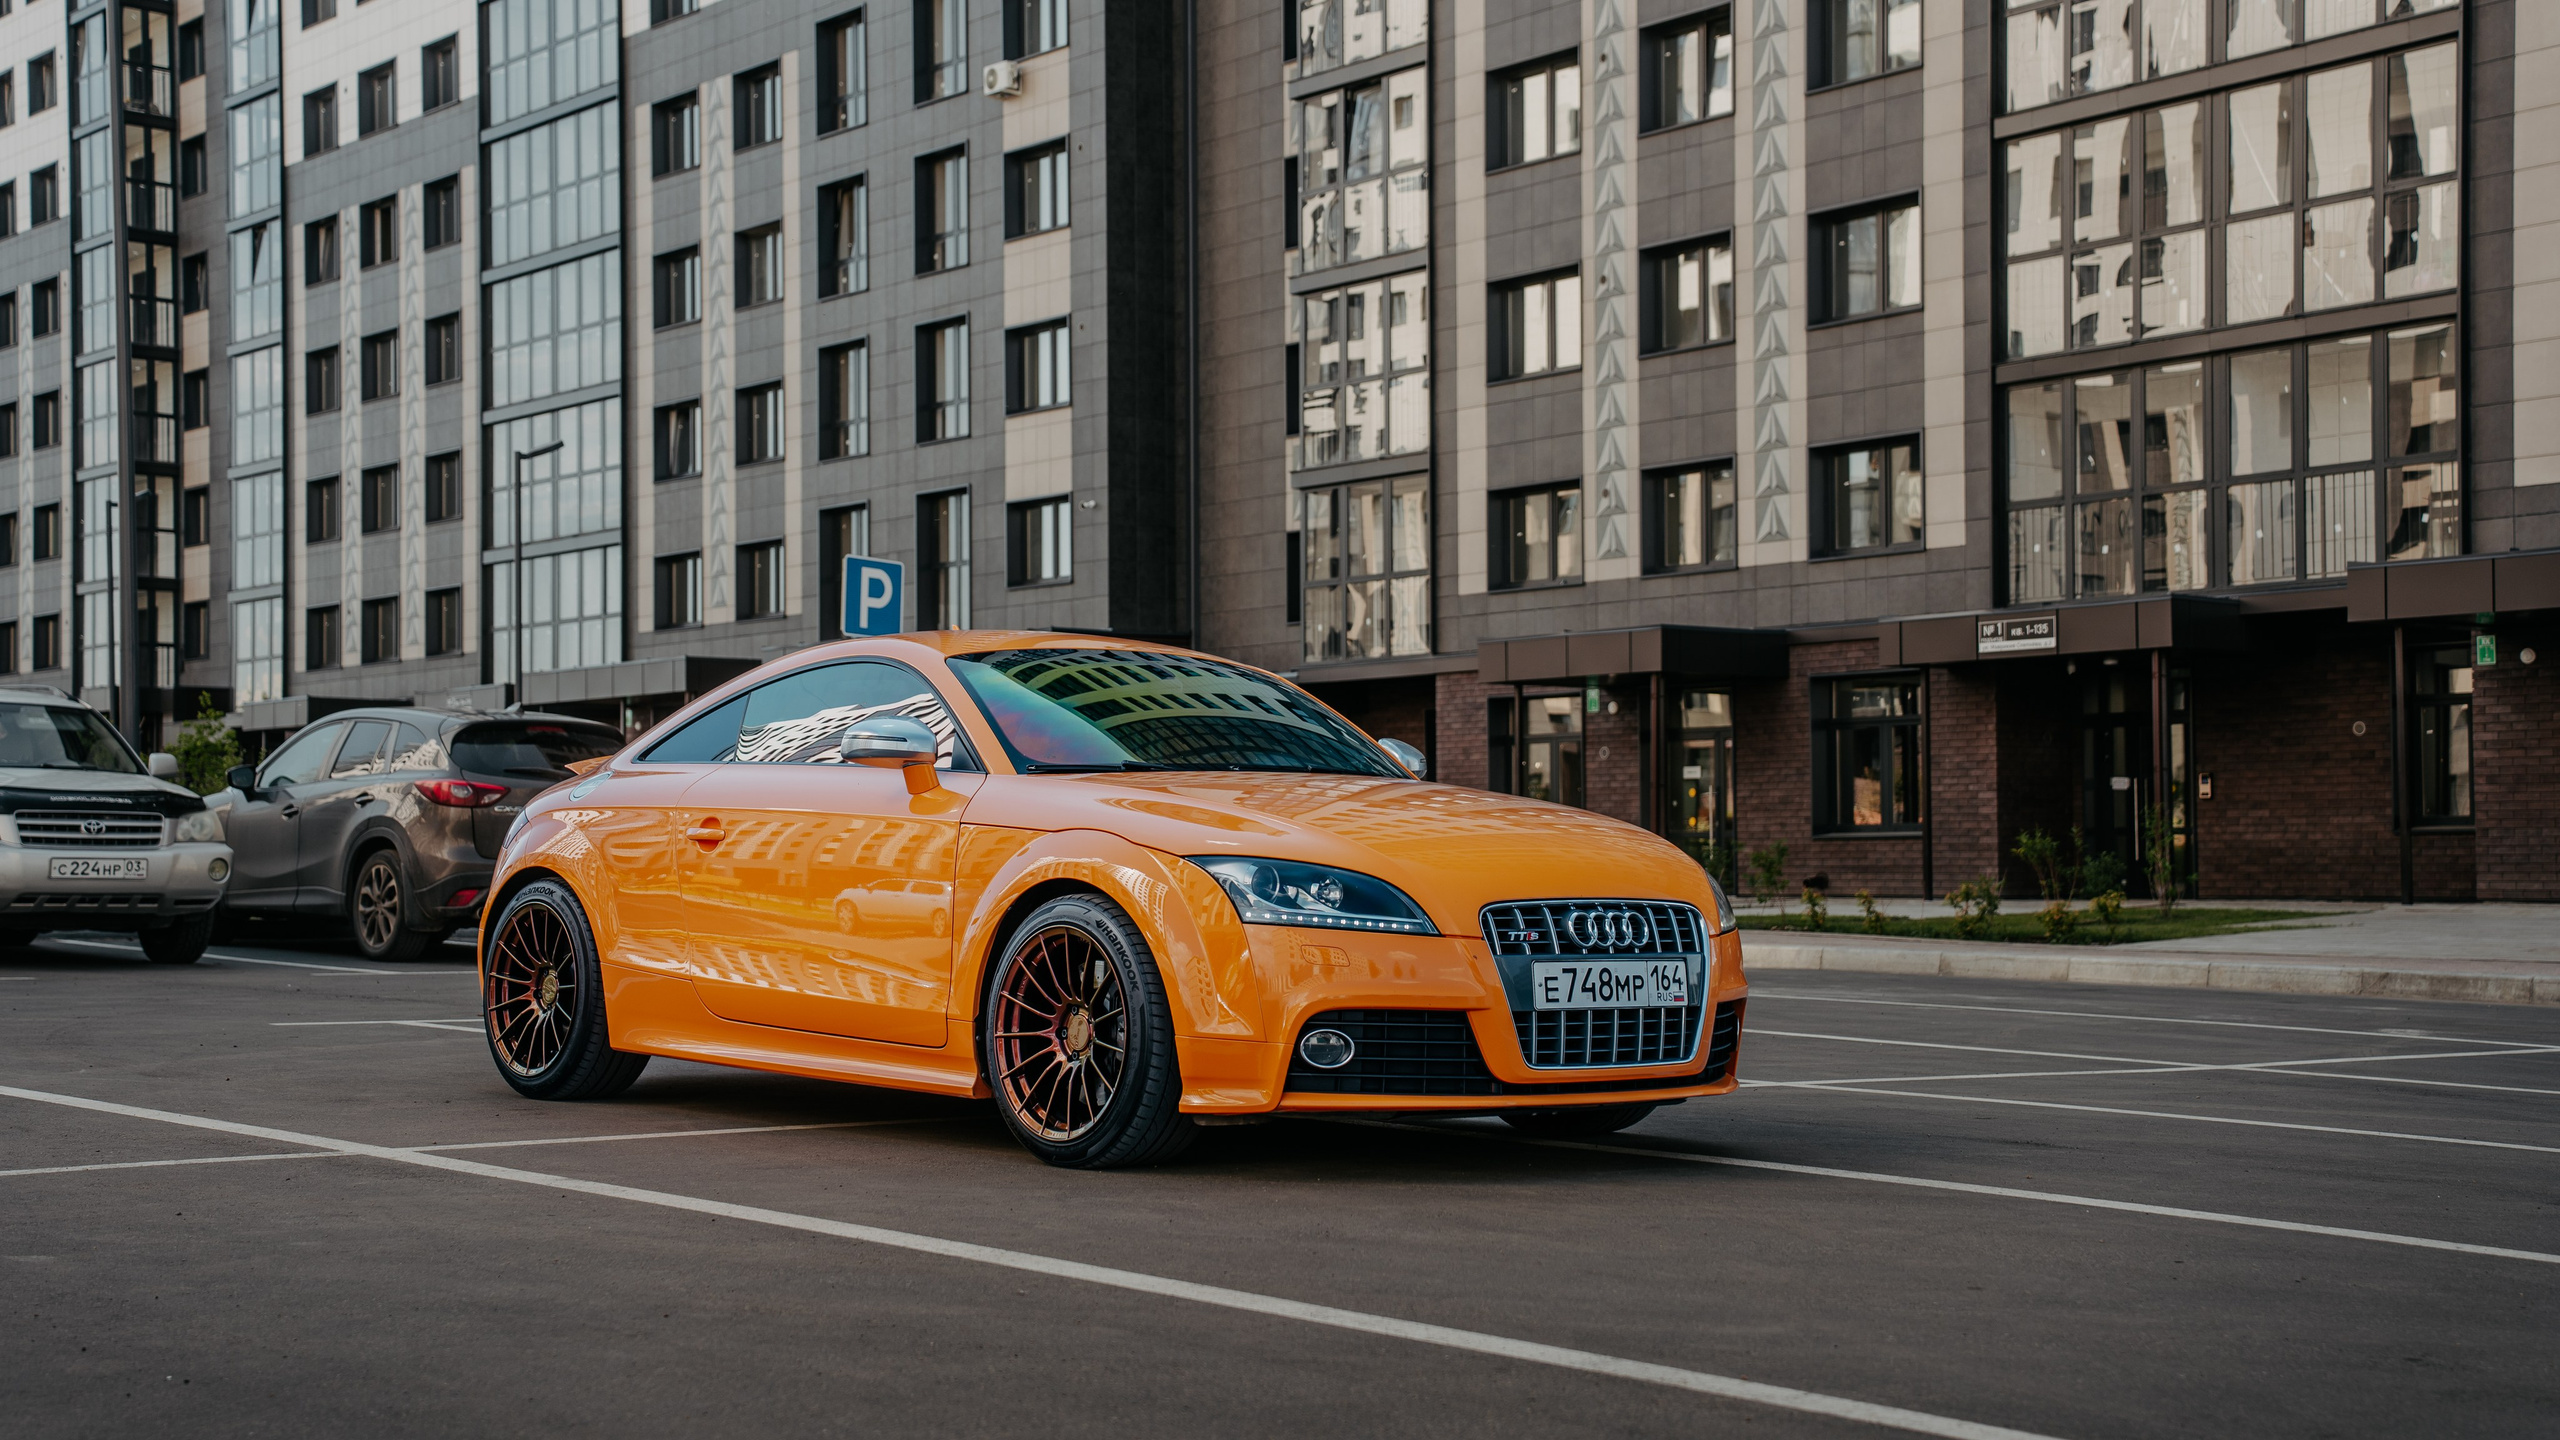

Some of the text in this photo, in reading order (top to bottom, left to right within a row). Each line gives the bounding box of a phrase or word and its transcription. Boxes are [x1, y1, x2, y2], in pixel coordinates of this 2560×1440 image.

[859, 566, 893, 629] P
[126, 860, 141, 872] 03
[1544, 965, 1684, 1003] E748MP 164
[1656, 992, 1674, 1002] RUS
